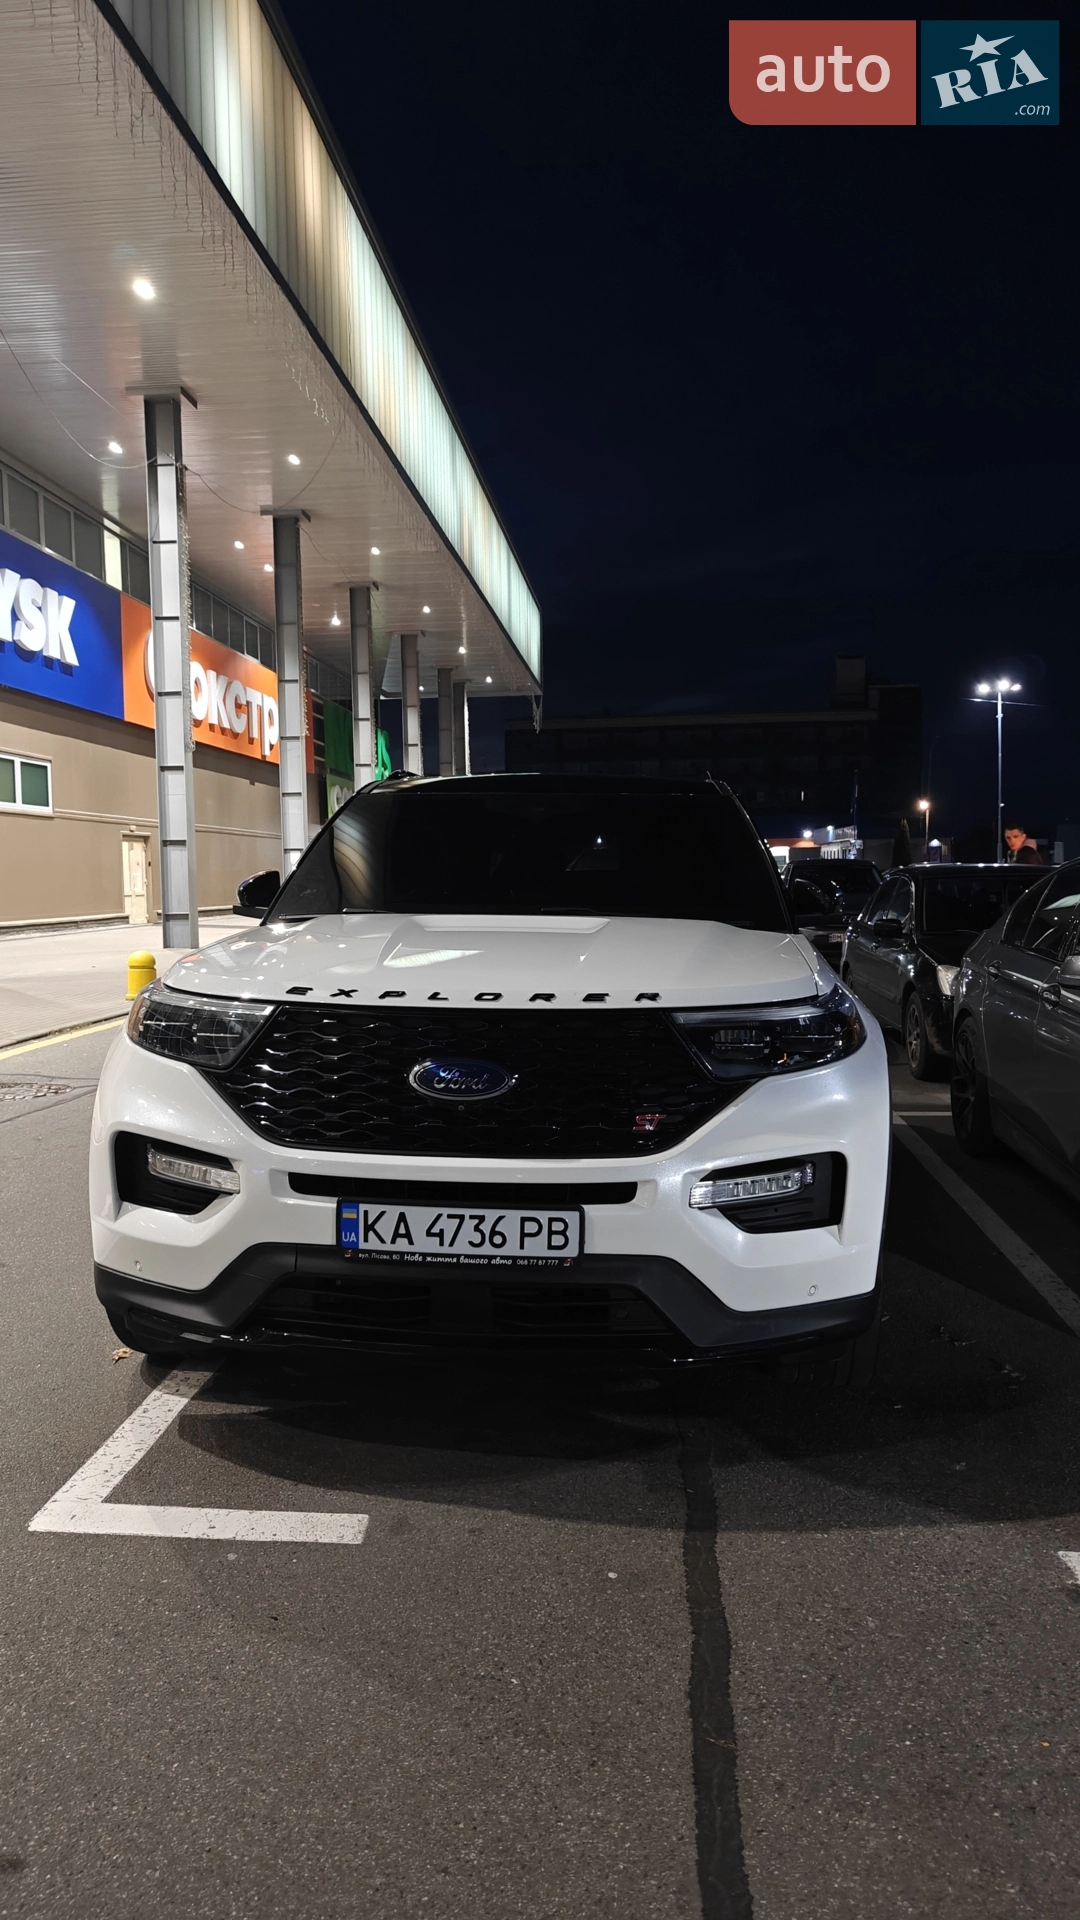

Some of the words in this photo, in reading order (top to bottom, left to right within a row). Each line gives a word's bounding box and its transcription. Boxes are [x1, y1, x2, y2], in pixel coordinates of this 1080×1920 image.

[285, 985, 663, 1003] EXPLORER
[433, 1066, 490, 1090] Ford
[633, 1114, 667, 1131] ST
[342, 1231, 357, 1243] UA
[362, 1209, 414, 1246] KA
[425, 1212, 507, 1249] 4736
[519, 1216, 570, 1251] PB
[404, 1253, 423, 1262] Нове
[425, 1255, 457, 1263] життя
[459, 1255, 489, 1264] вашого
[490, 1256, 513, 1265] авто
